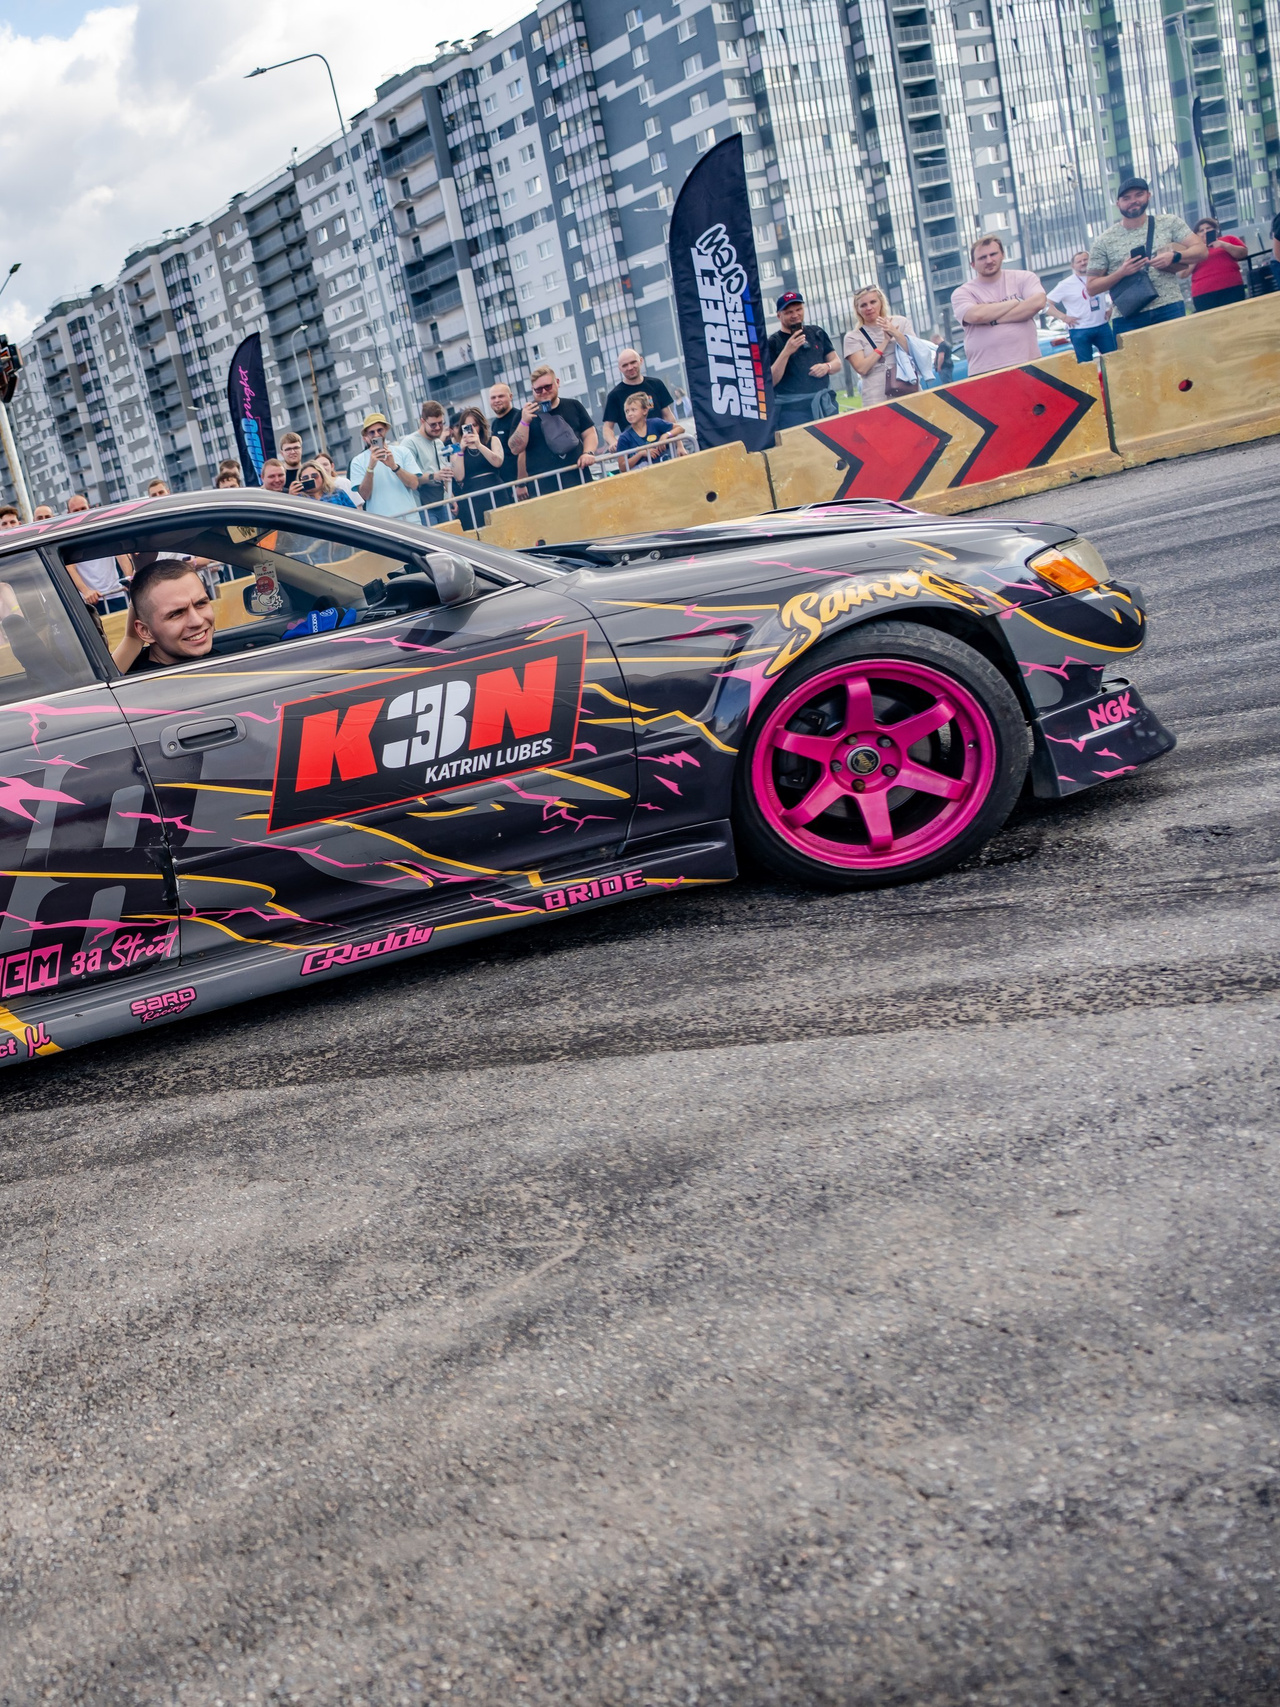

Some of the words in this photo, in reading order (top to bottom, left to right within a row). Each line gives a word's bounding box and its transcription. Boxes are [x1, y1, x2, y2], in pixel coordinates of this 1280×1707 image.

[690, 247, 741, 416] STREET
[724, 293, 759, 420] FIGHTERS
[1087, 691, 1137, 731] NGK
[424, 753, 492, 784] KATRIN
[495, 737, 553, 768] LUBES
[543, 869, 647, 911] BRIDE
[108, 925, 179, 971] Street
[142, 1002, 190, 1023] Racing
